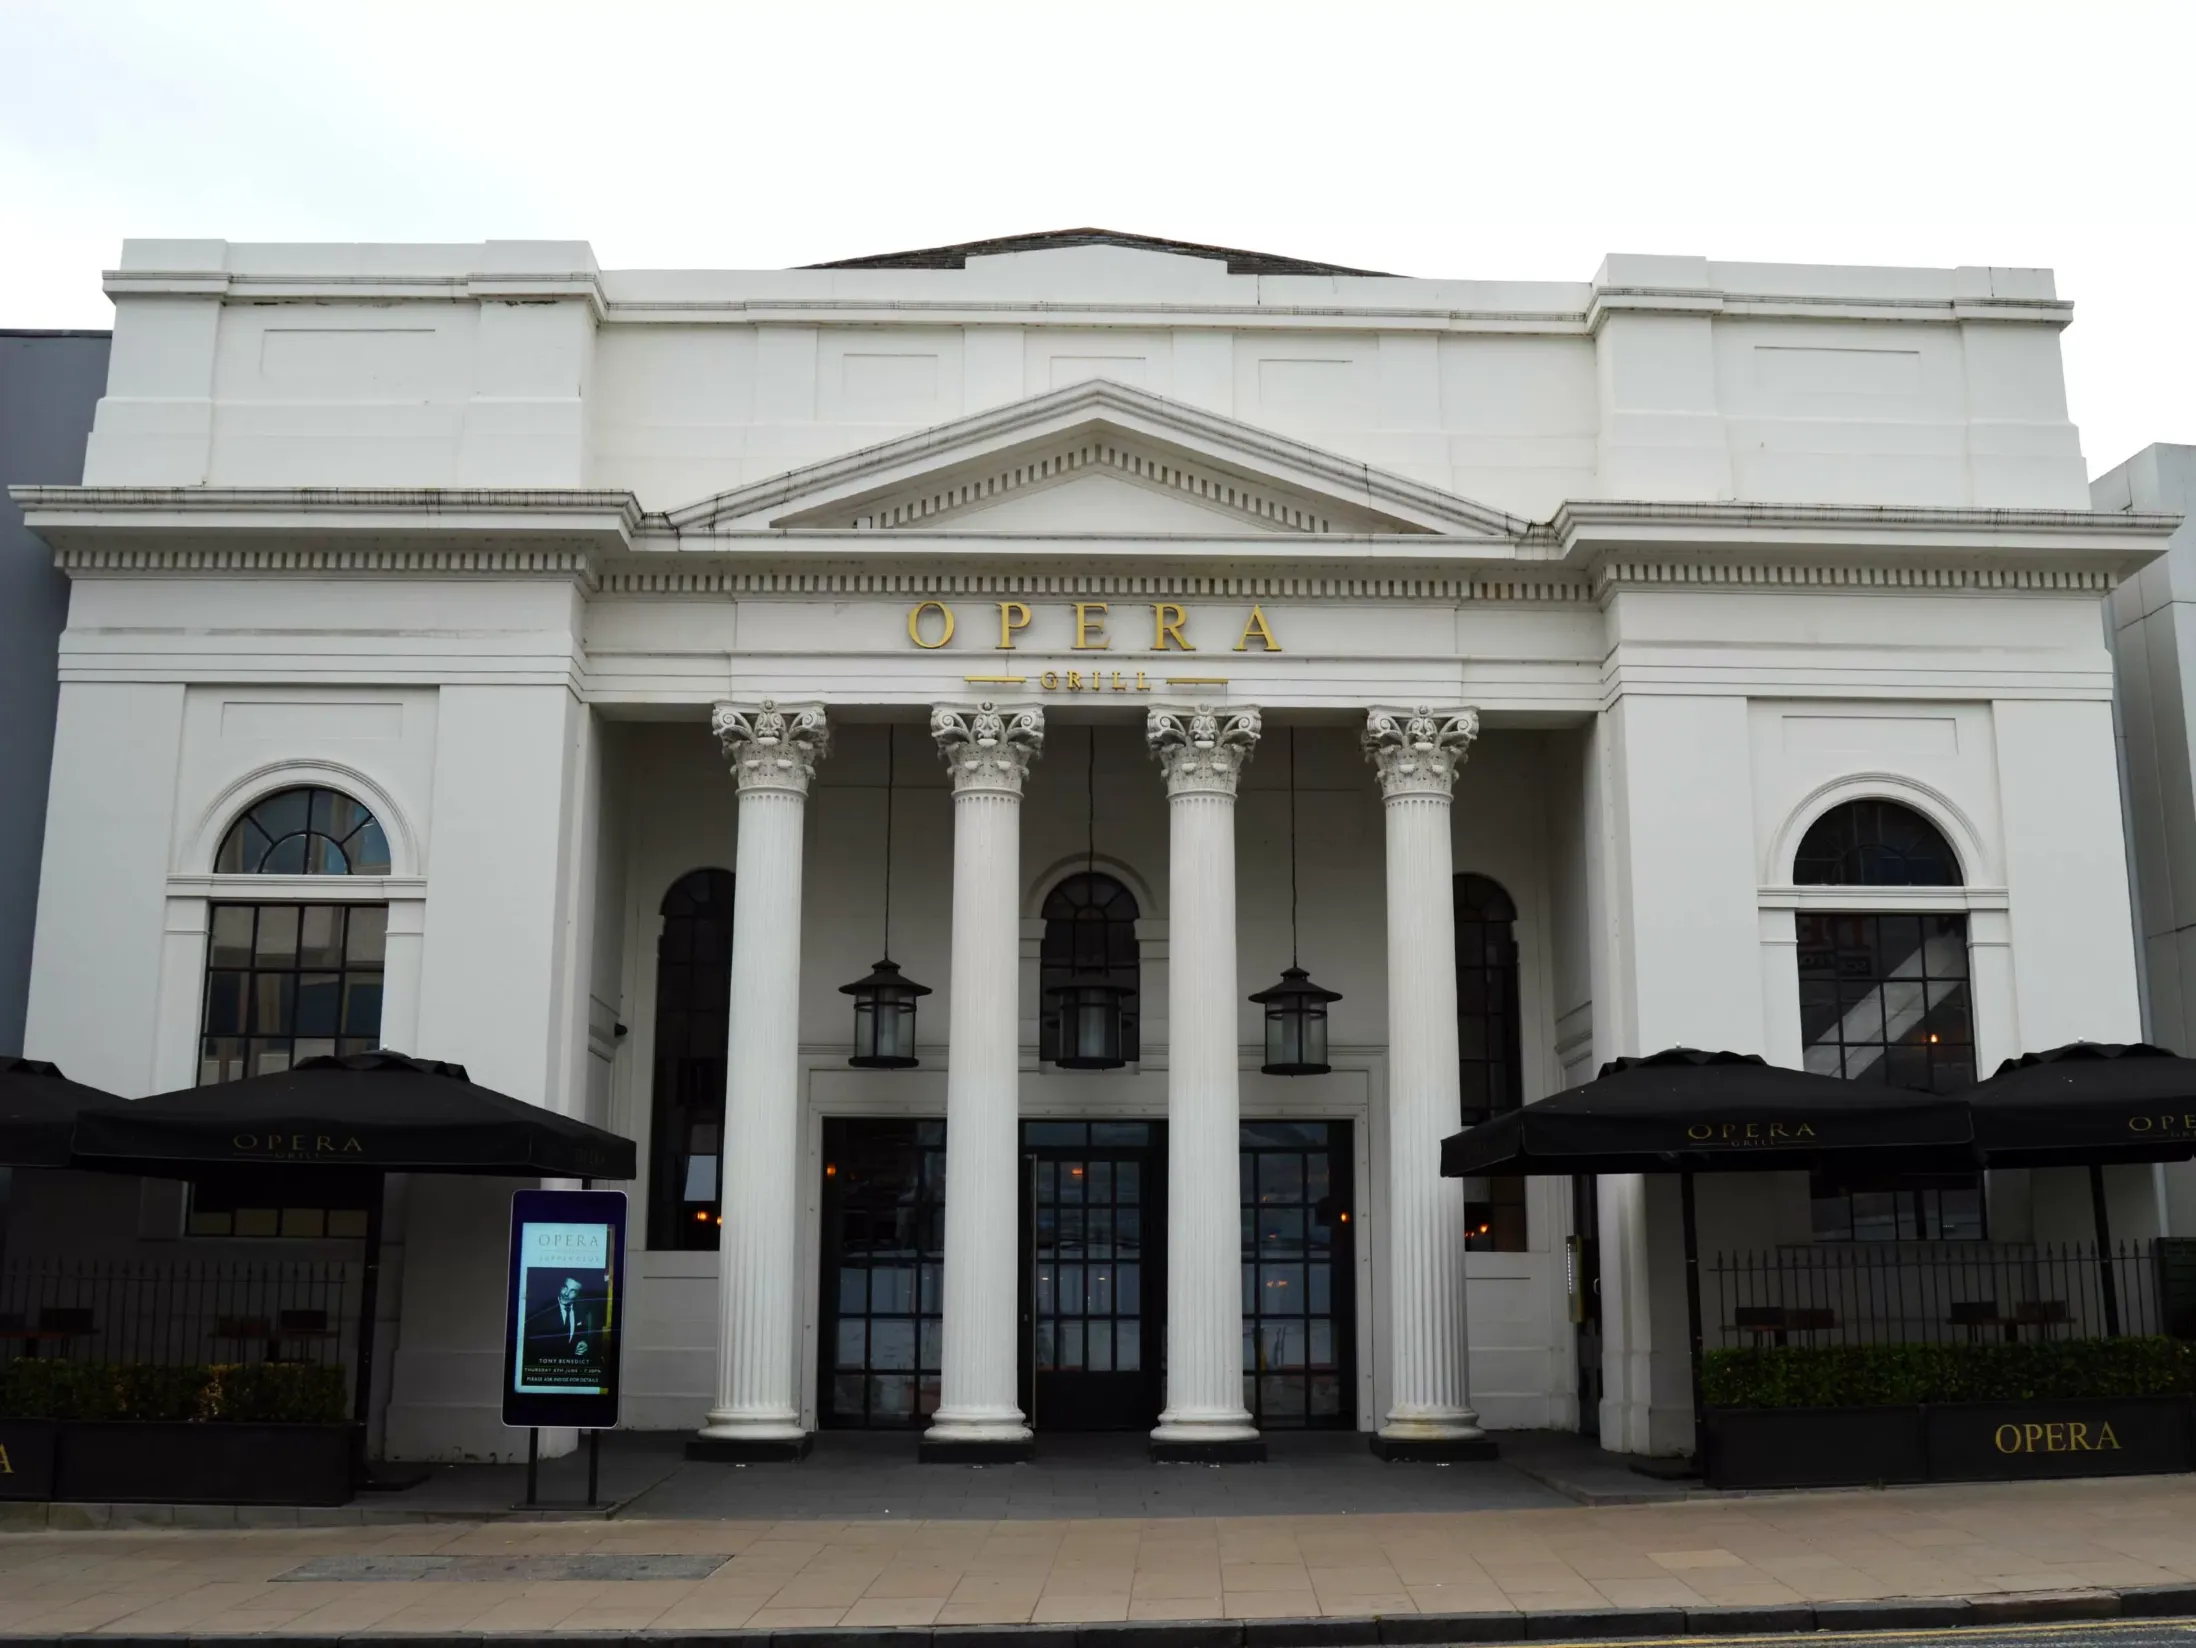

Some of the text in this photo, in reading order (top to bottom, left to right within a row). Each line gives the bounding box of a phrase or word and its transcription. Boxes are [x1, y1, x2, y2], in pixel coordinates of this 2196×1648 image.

[907, 600, 1283, 652] OPERA
[1040, 671, 1152, 691] GRILL
[1687, 1121, 1817, 1140] OPERA
[232, 1133, 364, 1152] OPERA
[1730, 1139, 1776, 1147] GRILL
[538, 1233, 599, 1247] OPERA
[1994, 1420, 2123, 1454] OPERA
